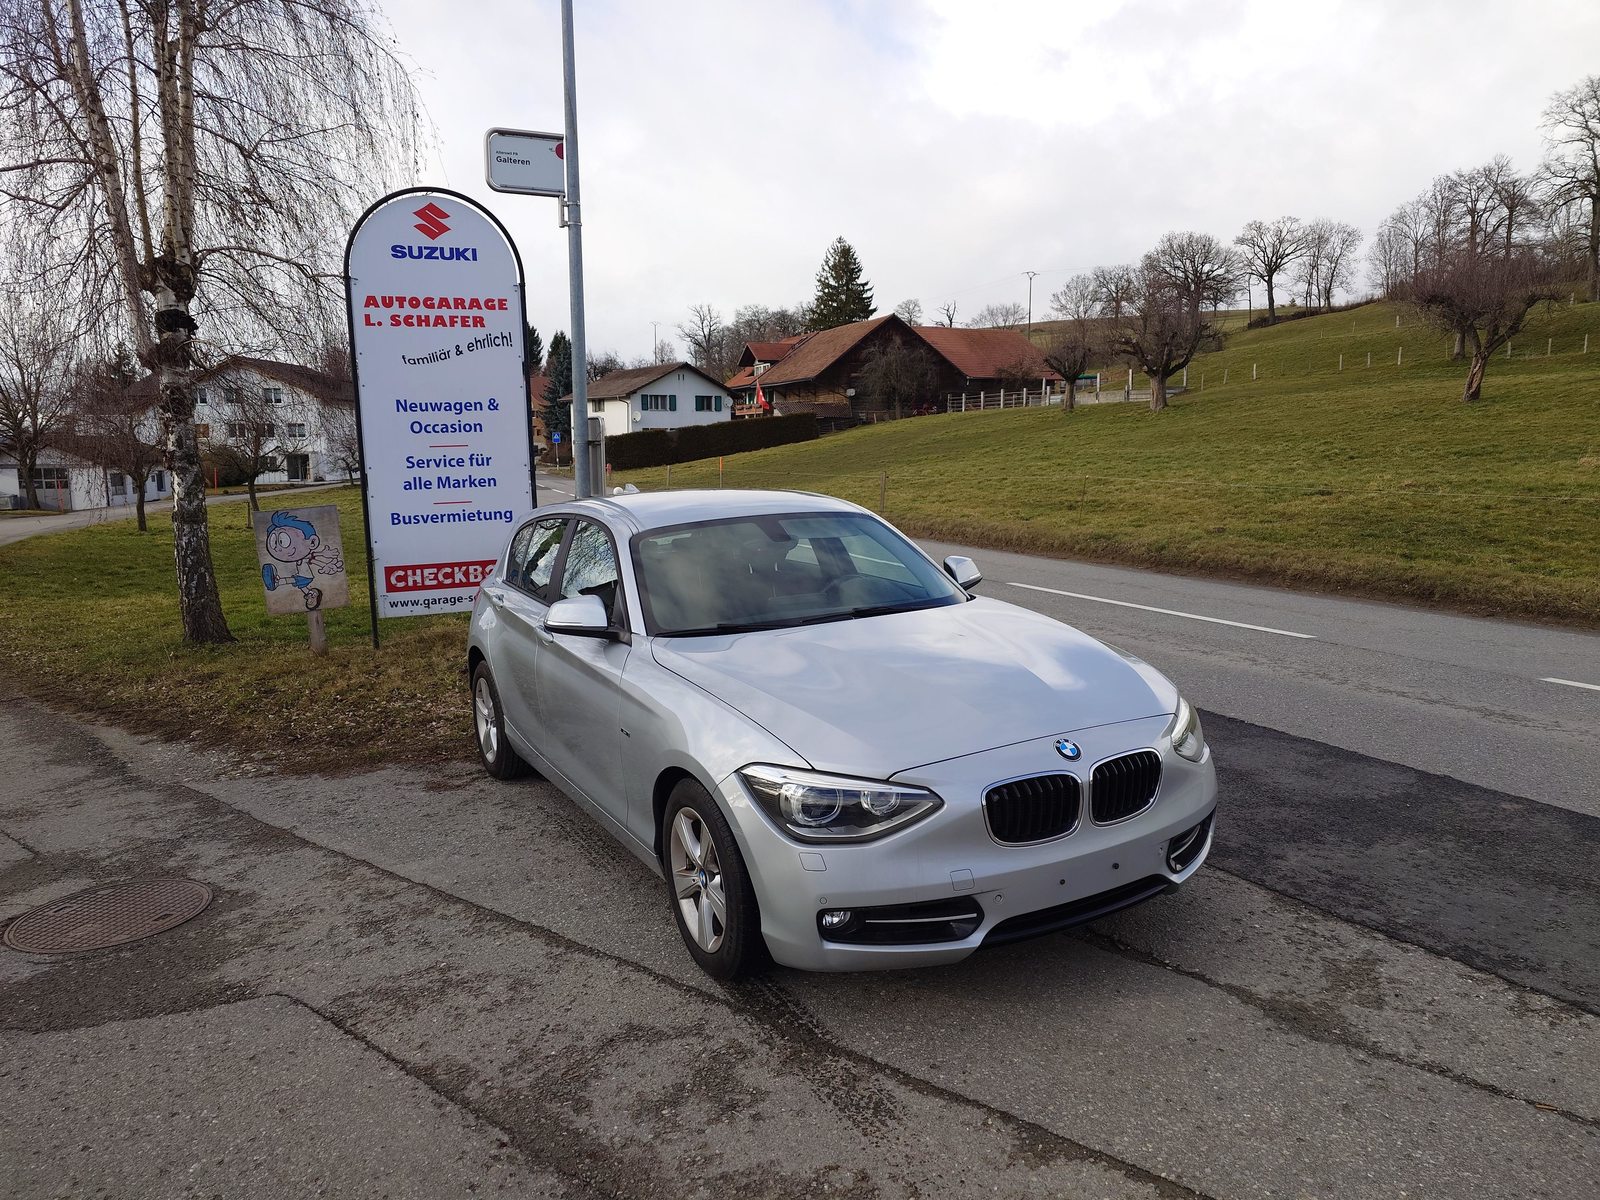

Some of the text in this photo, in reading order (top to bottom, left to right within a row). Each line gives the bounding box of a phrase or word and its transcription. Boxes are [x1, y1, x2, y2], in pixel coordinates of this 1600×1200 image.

[496, 156, 531, 165] Galteren
[391, 244, 478, 262] SUZUKI
[364, 295, 508, 310] AUTOGARAGE
[364, 314, 486, 328] L. SCHAFER
[401, 331, 513, 366] familiär & ehrlich!
[395, 398, 500, 415] Neuwagen &
[409, 420, 483, 435] Occasion
[405, 453, 492, 469] Service für
[402, 474, 497, 491] alle Marken
[390, 509, 513, 526] Busvermietung
